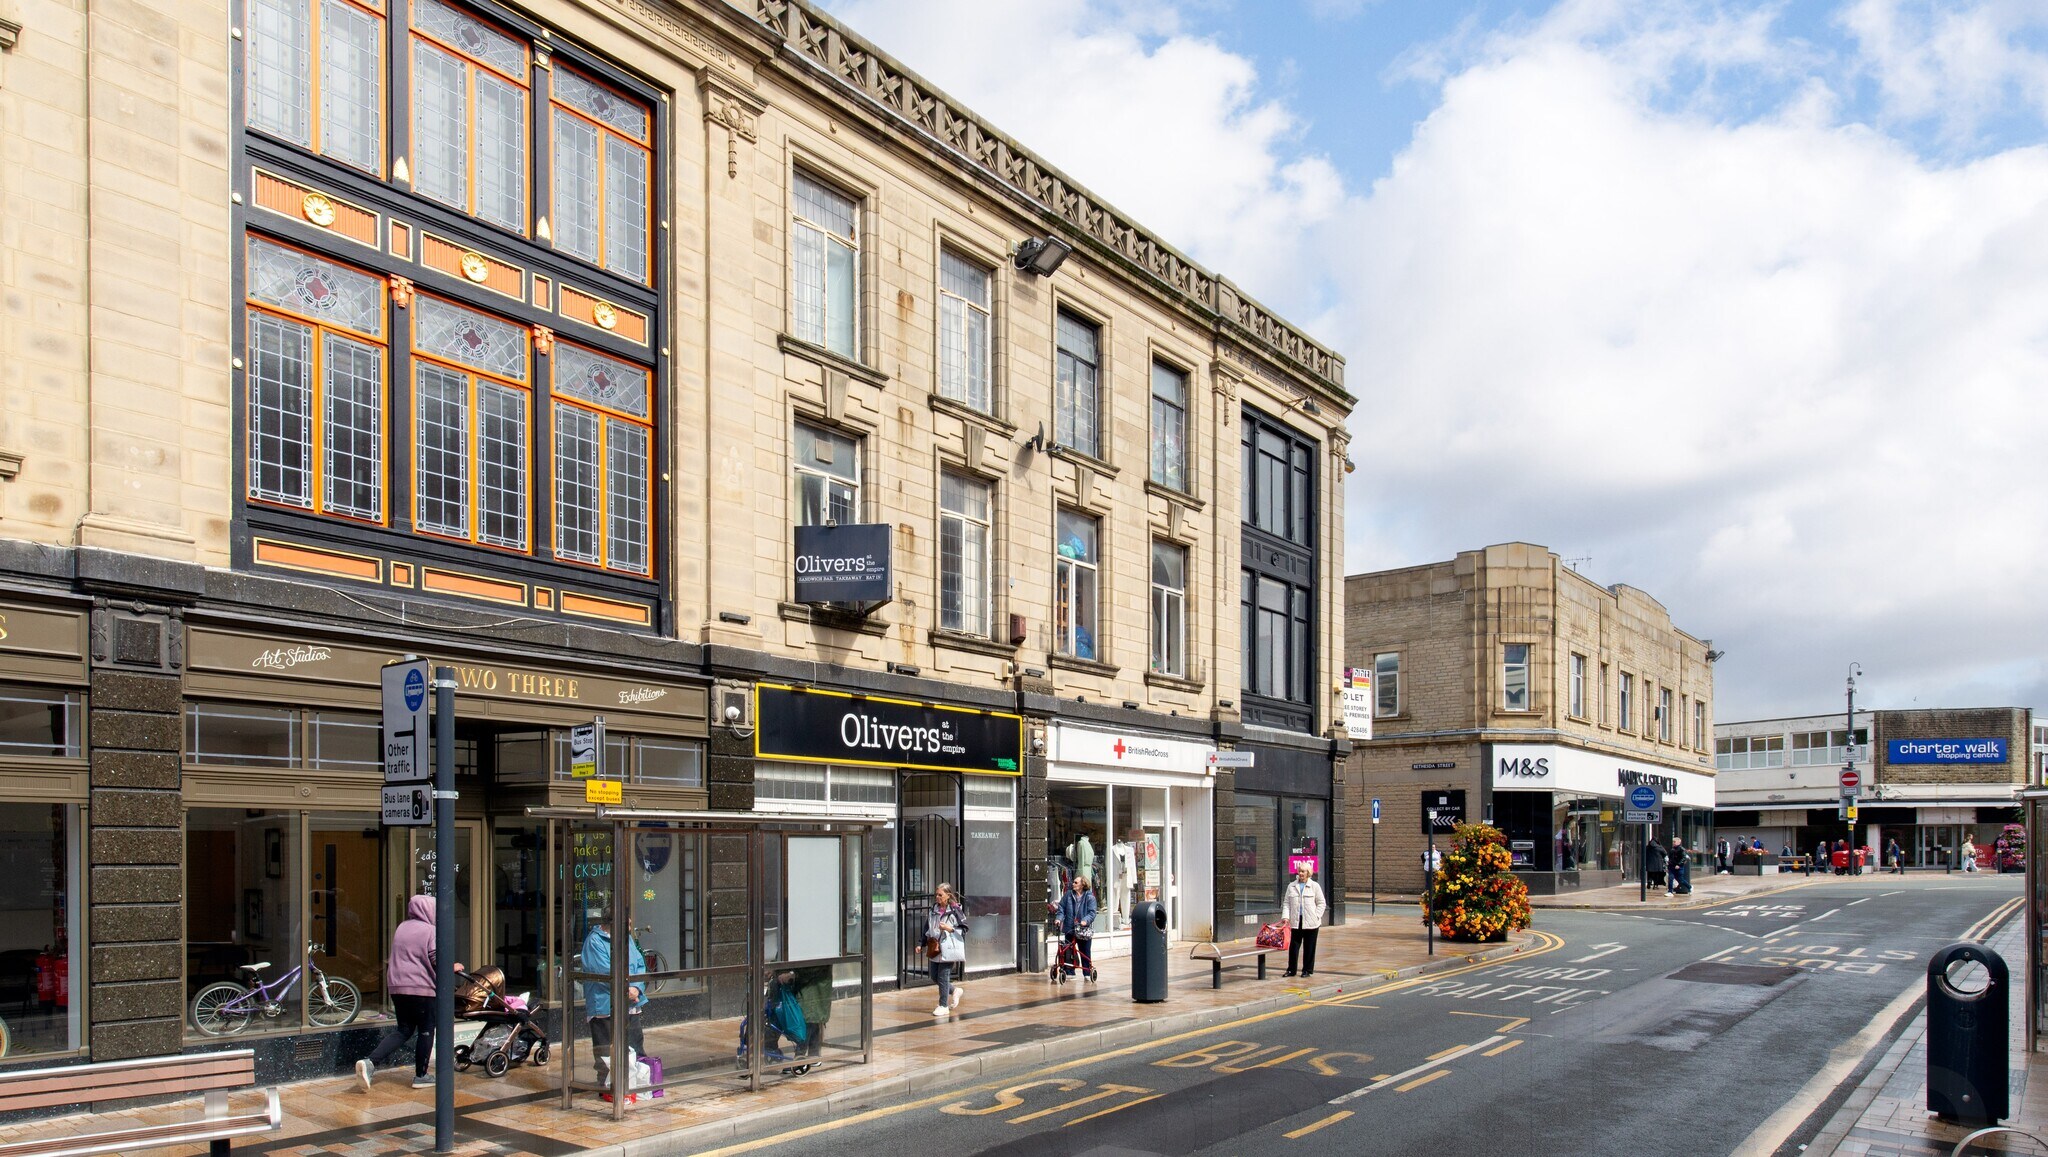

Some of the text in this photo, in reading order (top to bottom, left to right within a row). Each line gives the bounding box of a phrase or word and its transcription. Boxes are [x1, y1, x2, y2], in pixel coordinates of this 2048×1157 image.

[796, 555, 865, 573] Olivers
[252, 645, 331, 670] Art Studios
[508, 672, 579, 699] THREE
[618, 687, 667, 704] Exhibitions
[1351, 694, 1364, 702] LET
[942, 721, 950, 729] at
[841, 713, 941, 753] Olivers
[942, 732, 954, 741] the
[574, 738, 582, 746] Bus
[1900, 741, 1999, 754] charter walk
[387, 743, 409, 757] Other
[942, 745, 966, 754] empire
[1128, 746, 1169, 758] BritishRedCross
[1937, 752, 1971, 760] shopping
[387, 760, 411, 774] traffic
[1500, 757, 1549, 777] M&S
[384, 793, 411, 804] Bus lane
[385, 808, 411, 818] cameras
[1702, 910, 1807, 919] GATE
[1761, 944, 1919, 960] STOP
